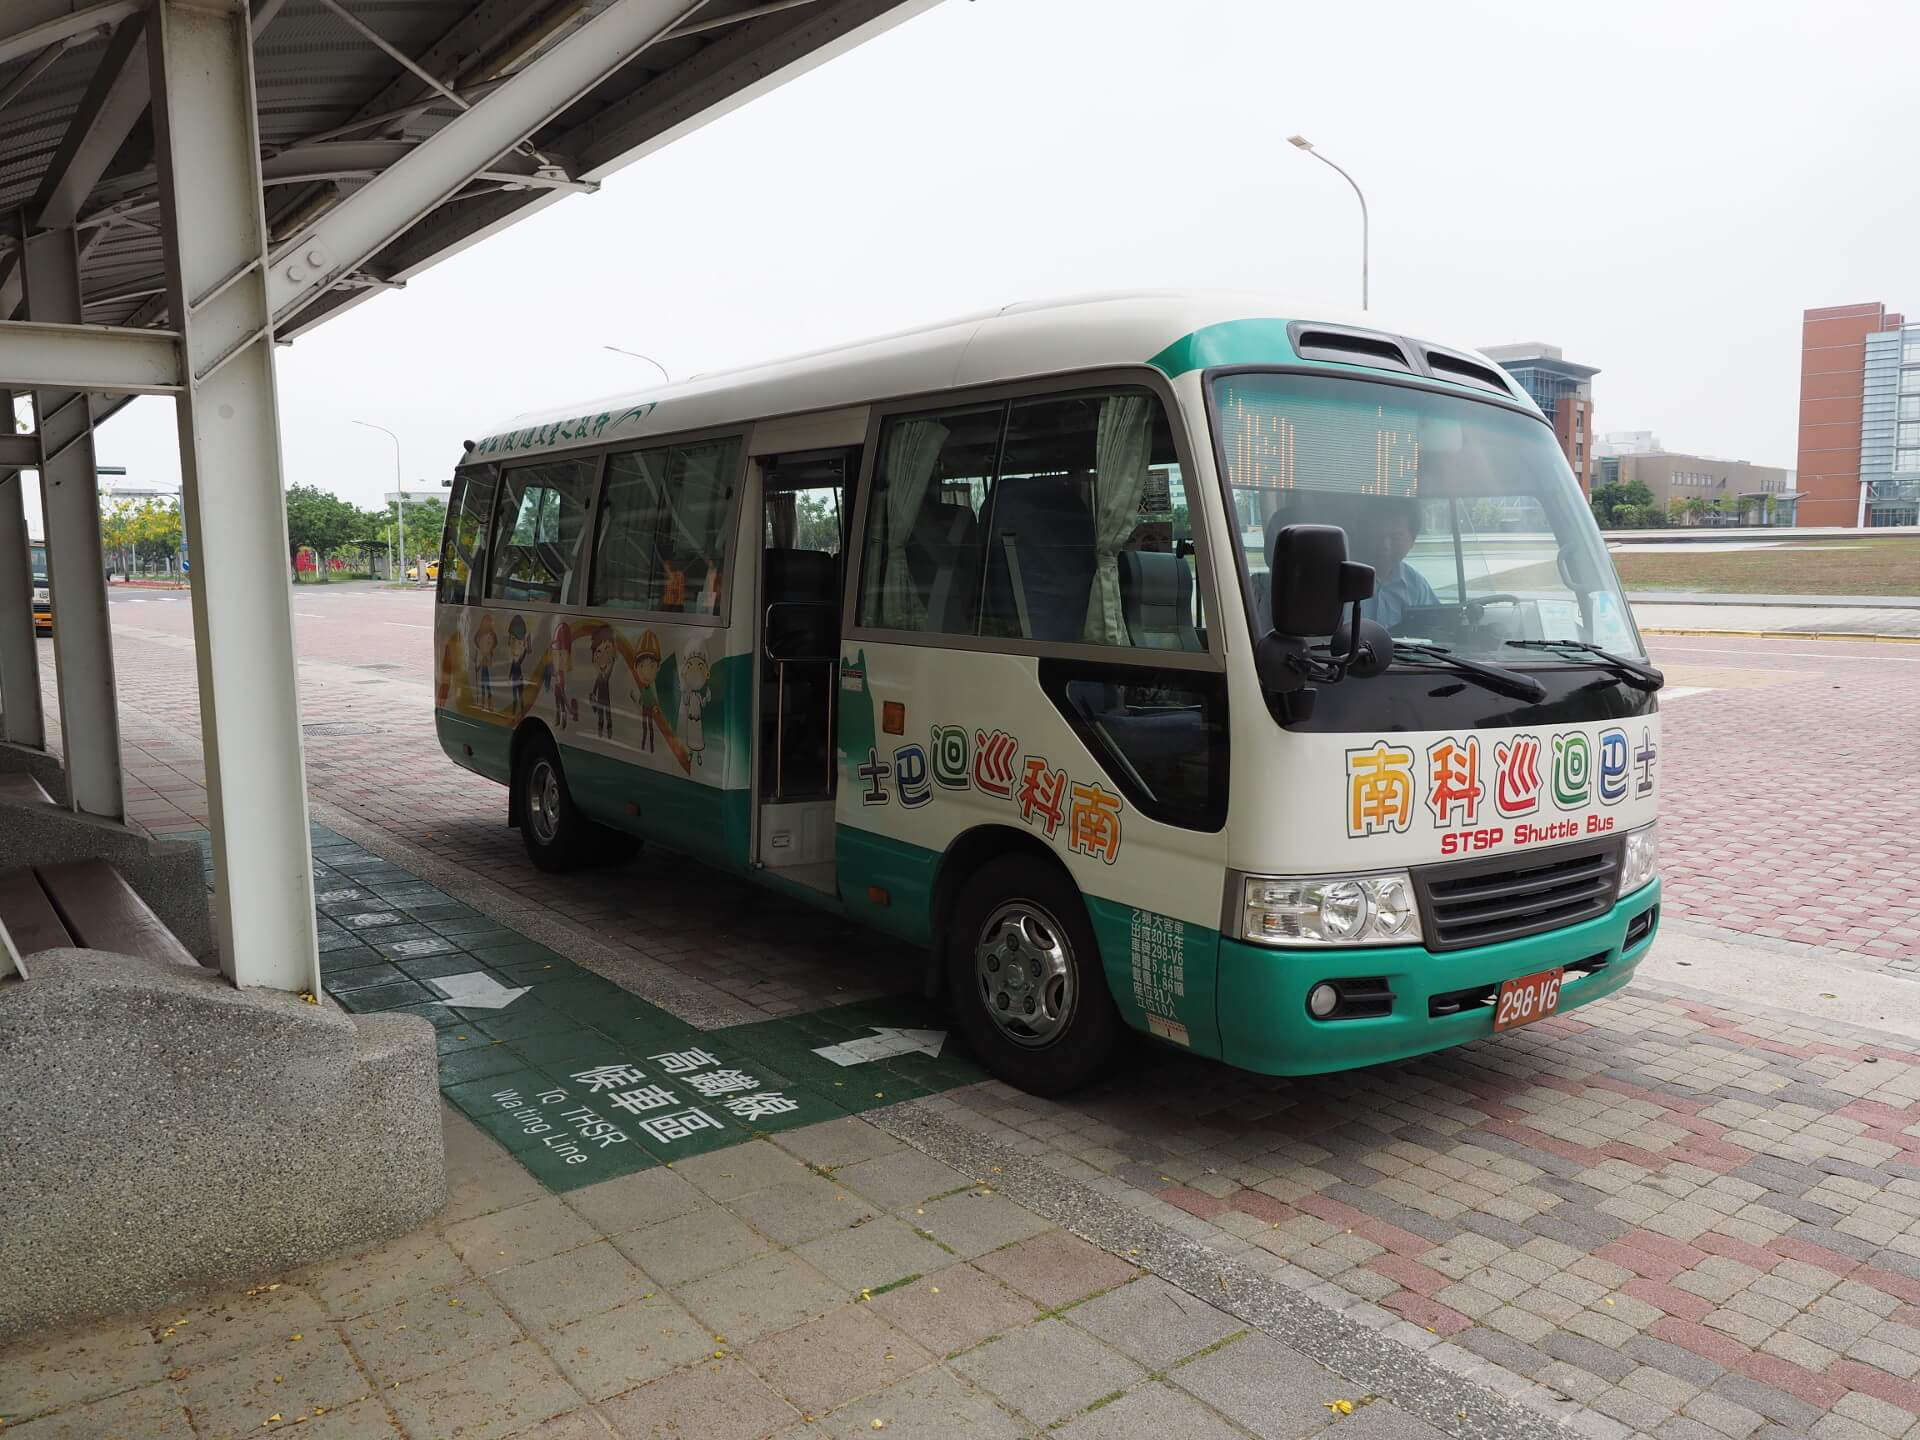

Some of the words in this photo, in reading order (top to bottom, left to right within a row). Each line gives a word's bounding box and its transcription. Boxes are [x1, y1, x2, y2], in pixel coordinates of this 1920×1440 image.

[1345, 726, 1657, 838] 南科巡迴巴士
[1441, 827, 1504, 854] STSP
[1513, 819, 1579, 845] Shuttle
[1586, 815, 1614, 834] Bus
[569, 1064, 725, 1143] 候車區
[647, 1047, 799, 1120] 高鐵線
[490, 1088, 552, 1134] Waiting
[542, 1132, 588, 1164] Line
[560, 1105, 629, 1148] THSR
